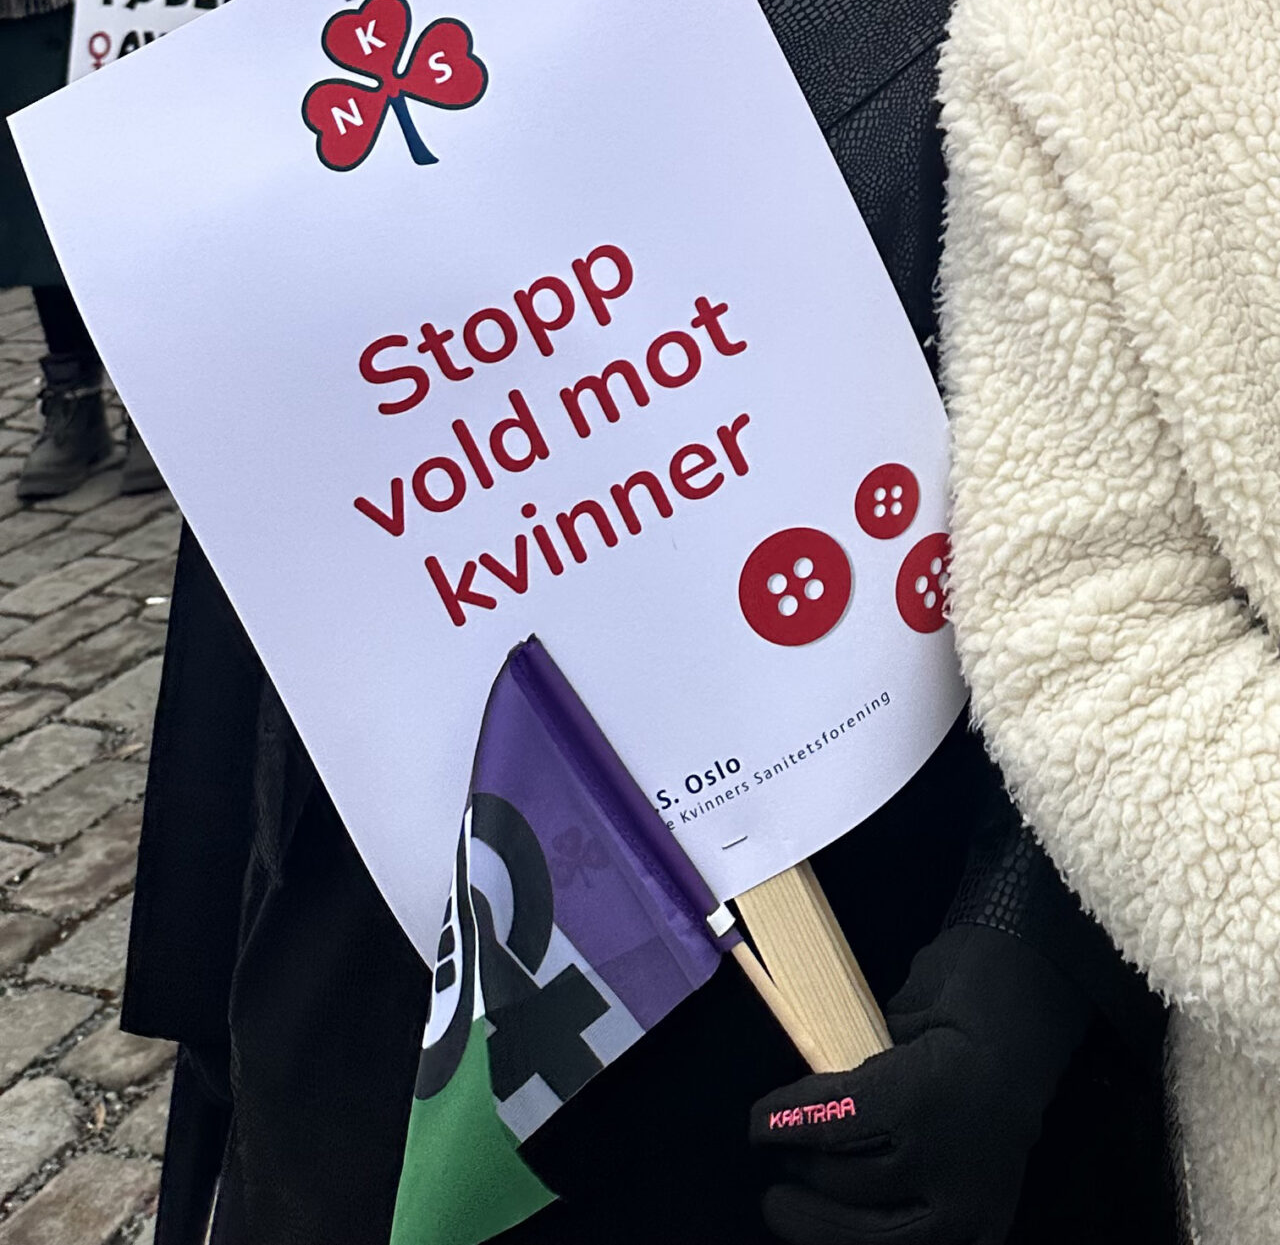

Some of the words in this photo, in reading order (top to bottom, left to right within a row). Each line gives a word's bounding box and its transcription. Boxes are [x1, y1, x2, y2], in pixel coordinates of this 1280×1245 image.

[331, 98, 364, 136] N
[355, 19, 387, 56] K
[428, 51, 453, 85] S
[358, 244, 633, 415] Stopp
[353, 389, 550, 536] vold
[559, 296, 748, 438] mot
[425, 412, 751, 627] kvinner
[680, 780, 750, 824] Kvinners
[753, 690, 891, 785] Sanitetsforening
[684, 757, 742, 794] Oslo
